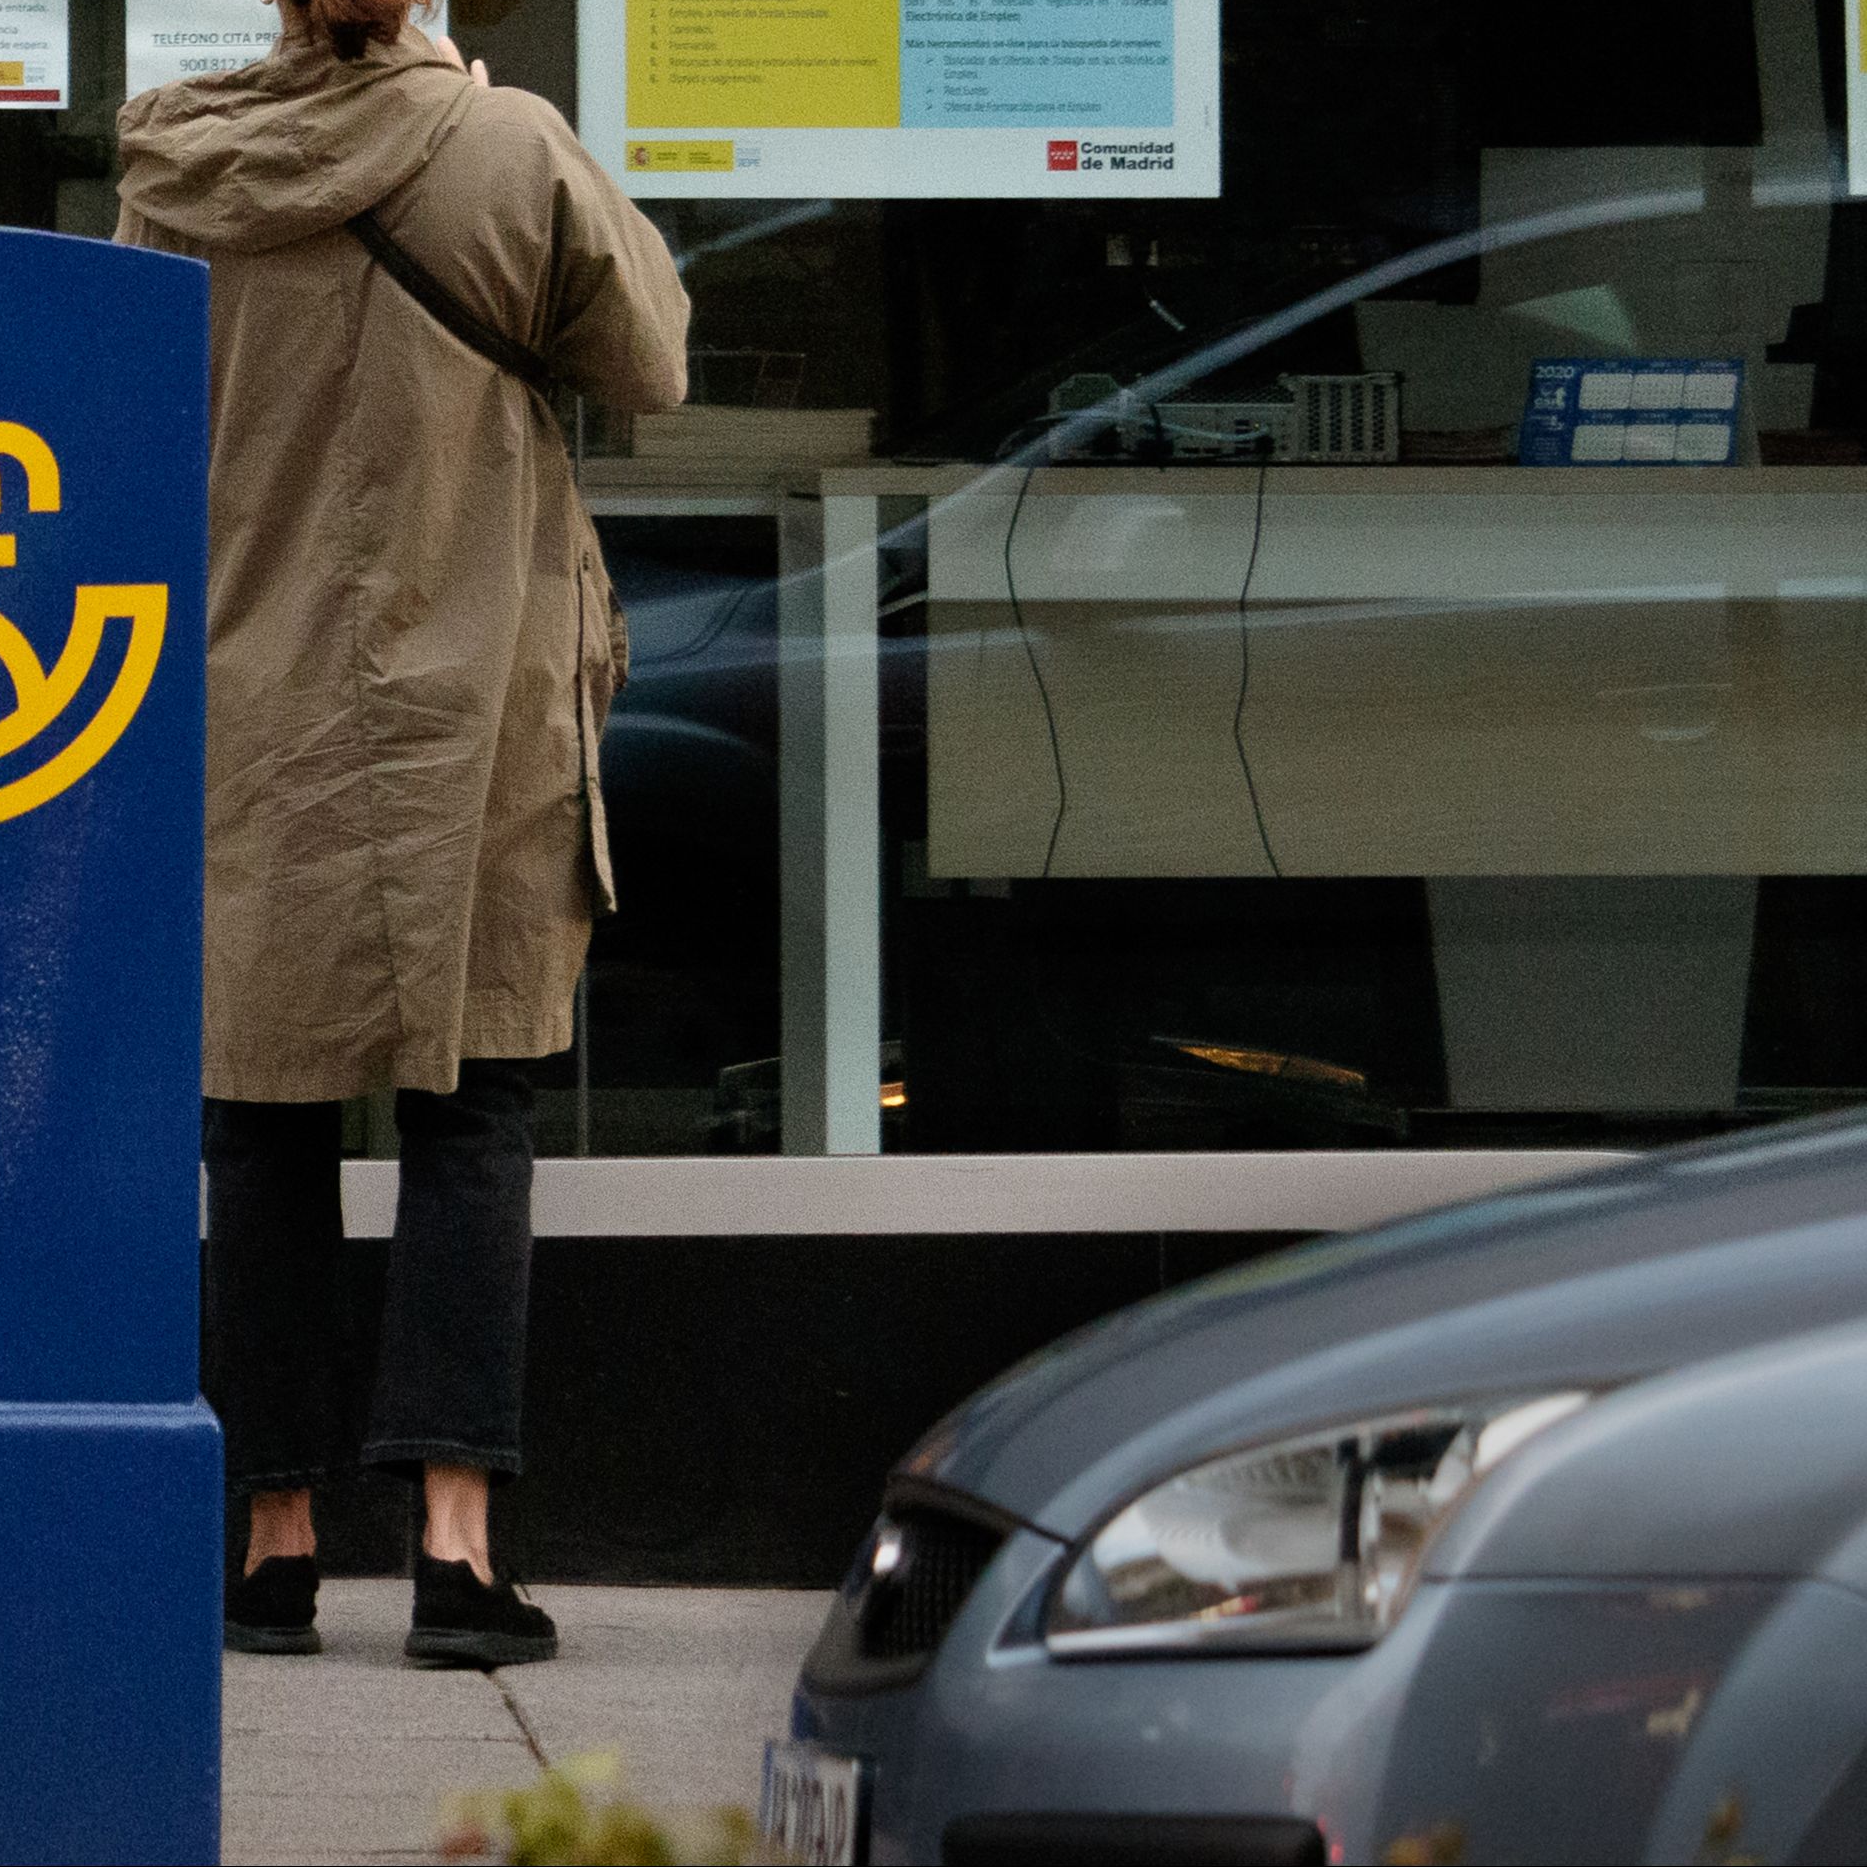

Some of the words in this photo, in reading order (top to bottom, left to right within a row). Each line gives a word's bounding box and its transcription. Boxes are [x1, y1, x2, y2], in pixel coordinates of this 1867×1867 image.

[152, 31, 219, 44] TELÉFONO
[222, 33, 251, 43] CITA
[178, 58, 207, 71] 900
[209, 58, 237, 71] 812
[1081, 143, 1174, 153] Comunidad
[1081, 158, 1103, 169] de
[1110, 157, 1174, 169] Madrid
[1535, 366, 1574, 380] 2020
